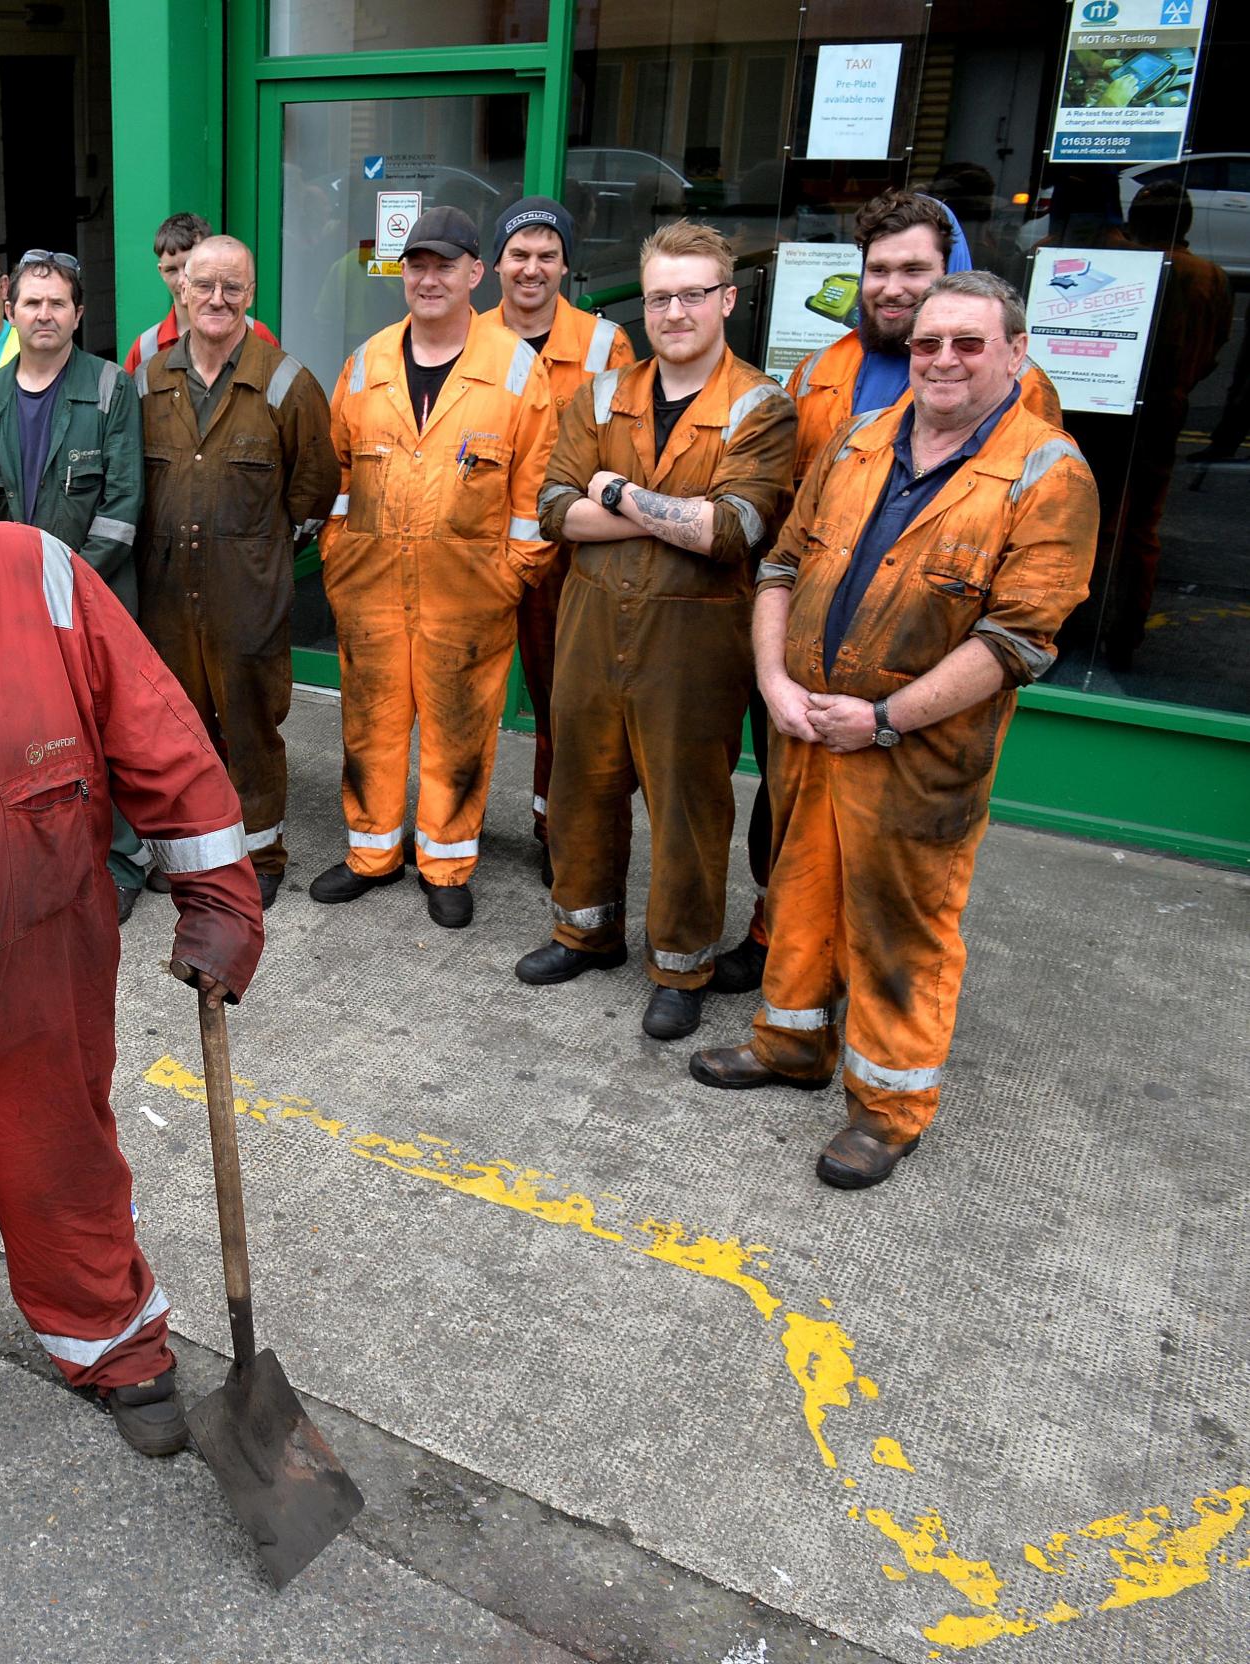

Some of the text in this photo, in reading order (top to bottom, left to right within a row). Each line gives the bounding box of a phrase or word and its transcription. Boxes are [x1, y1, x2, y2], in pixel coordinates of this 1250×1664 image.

[1078, 34, 1157, 44] MOT Re-Testing
[845, 59, 872, 70] TAXI
[836, 80, 877, 88] Pre-Plate
[824, 95, 863, 104] available
[1061, 137, 1131, 146] 01633 261888
[808, 251, 842, 259] changing
[1048, 287, 1145, 316] TOP SECRET
[1032, 327, 1067, 335] OFFICIAL
[1069, 328, 1099, 337] RESULTS
[45, 737, 76, 750] NEWPORT
